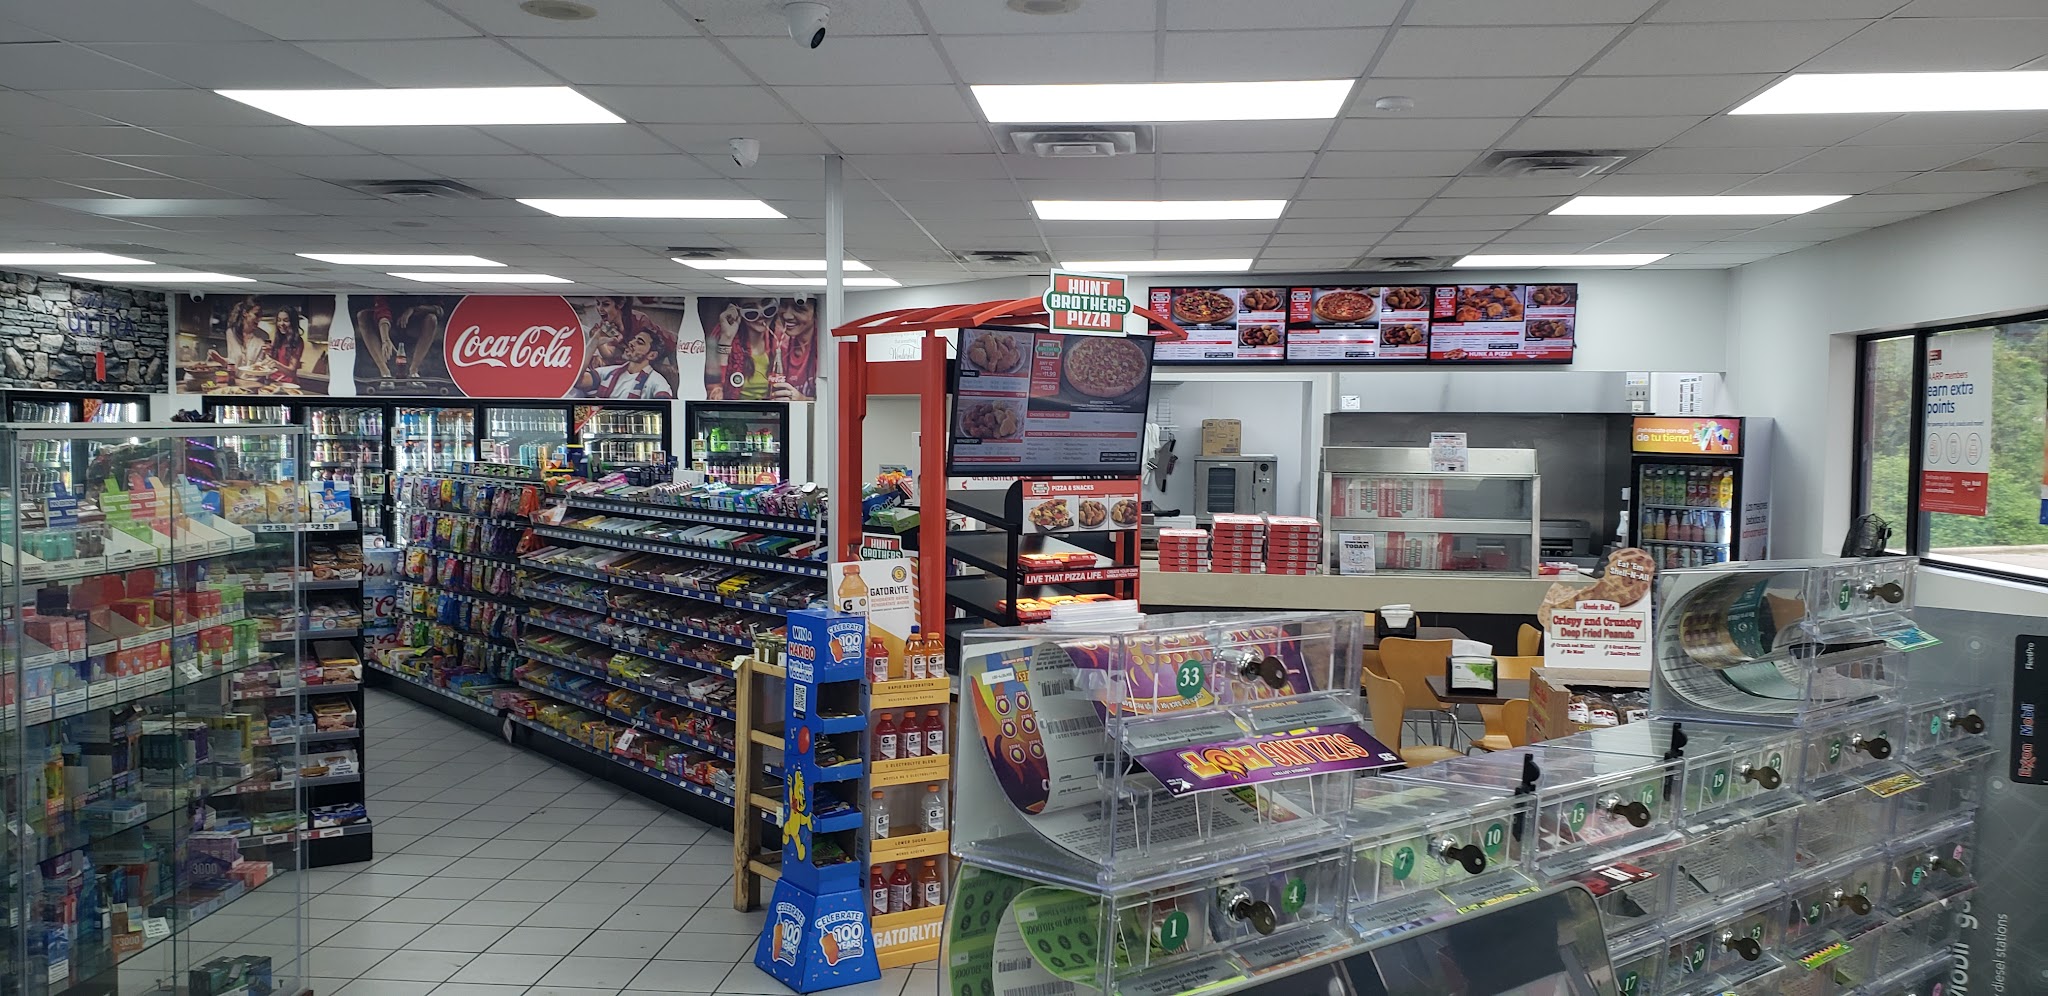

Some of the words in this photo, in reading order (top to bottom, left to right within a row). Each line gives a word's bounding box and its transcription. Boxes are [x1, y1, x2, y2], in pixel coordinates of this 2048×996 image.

[1068, 279, 1111, 297] HUNT
[1050, 294, 1128, 313] BROTHERS
[67, 310, 135, 338] ULTRA
[1066, 311, 1111, 328] PIZZA
[452, 324, 577, 369] Coca-Cola
[1944, 370, 1969, 380] members
[1927, 386, 1948, 397] earn
[1950, 383, 1974, 396] extra
[1927, 398, 1956, 418] points
[1636, 433, 1650, 442] de
[1651, 434, 1662, 443] tu
[1662, 433, 1693, 443] tierra!
[1051, 484, 1067, 492] PIZZA
[1072, 484, 1095, 492] SNACKS
[870, 538, 893, 550] HUNT
[862, 547, 901, 559] BROTHERS
[1616, 559, 1629, 568] Eat
[1630, 562, 1644, 571] 'Em
[1026, 575, 1043, 584] LIVE
[1044, 573, 1063, 583] THAT
[1064, 572, 1086, 581] PIZZA
[1086, 571, 1103, 580] LIFE.
[1609, 566, 1650, 582] Shell-N-All
[870, 585, 909, 597] GATORLYTE
[1840, 590, 1849, 603] 31
[843, 600, 853, 611] G
[827, 623, 864, 634] CELEBRATE!
[1552, 615, 1582, 627] Crispy
[1584, 617, 1601, 626] and
[1603, 616, 1642, 629] Crunchy
[792, 626, 808, 642] WIN
[841, 634, 861, 646] 100
[1560, 627, 1580, 639] Deep
[1582, 628, 1602, 638] Fried
[1603, 629, 1635, 639] Peanuts
[788, 641, 816, 661] HARIBO
[2025, 641, 2035, 670] FleetPro
[789, 667, 814, 683] Vacation
[1180, 666, 1200, 688] 33
[2019, 703, 2035, 738] Mobil
[1256, 733, 1369, 766] SIZZLING
[1830, 745, 1840, 756] 25
[1177, 745, 1272, 780] HOT
[2018, 743, 2033, 778] Exxon
[1715, 774, 1725, 787] 19
[1641, 788, 1653, 800] 16
[1572, 808, 1585, 823] 13
[1487, 830, 1500, 846] 10
[192, 862, 218, 875] 3000
[1399, 852, 1408, 870] 7
[906, 886, 911, 894] G
[1288, 886, 1298, 903] 4
[776, 902, 806, 924] CELEBRATE!
[815, 911, 864, 928] CELEBRATE!
[783, 920, 800, 943] 100
[835, 924, 862, 941] 100
[873, 920, 943, 948] GATORLYTE
[1026, 922, 1055, 936] $10,000!
[1169, 919, 1178, 938] 1
[1752, 926, 1761, 939] 23
[1993, 913, 2008, 958] stations
[837, 940, 862, 951] YEARS
[1693, 948, 1705, 964] 20
[1625, 975, 1637, 991] 17
[1991, 958, 2006, 992] diesel
